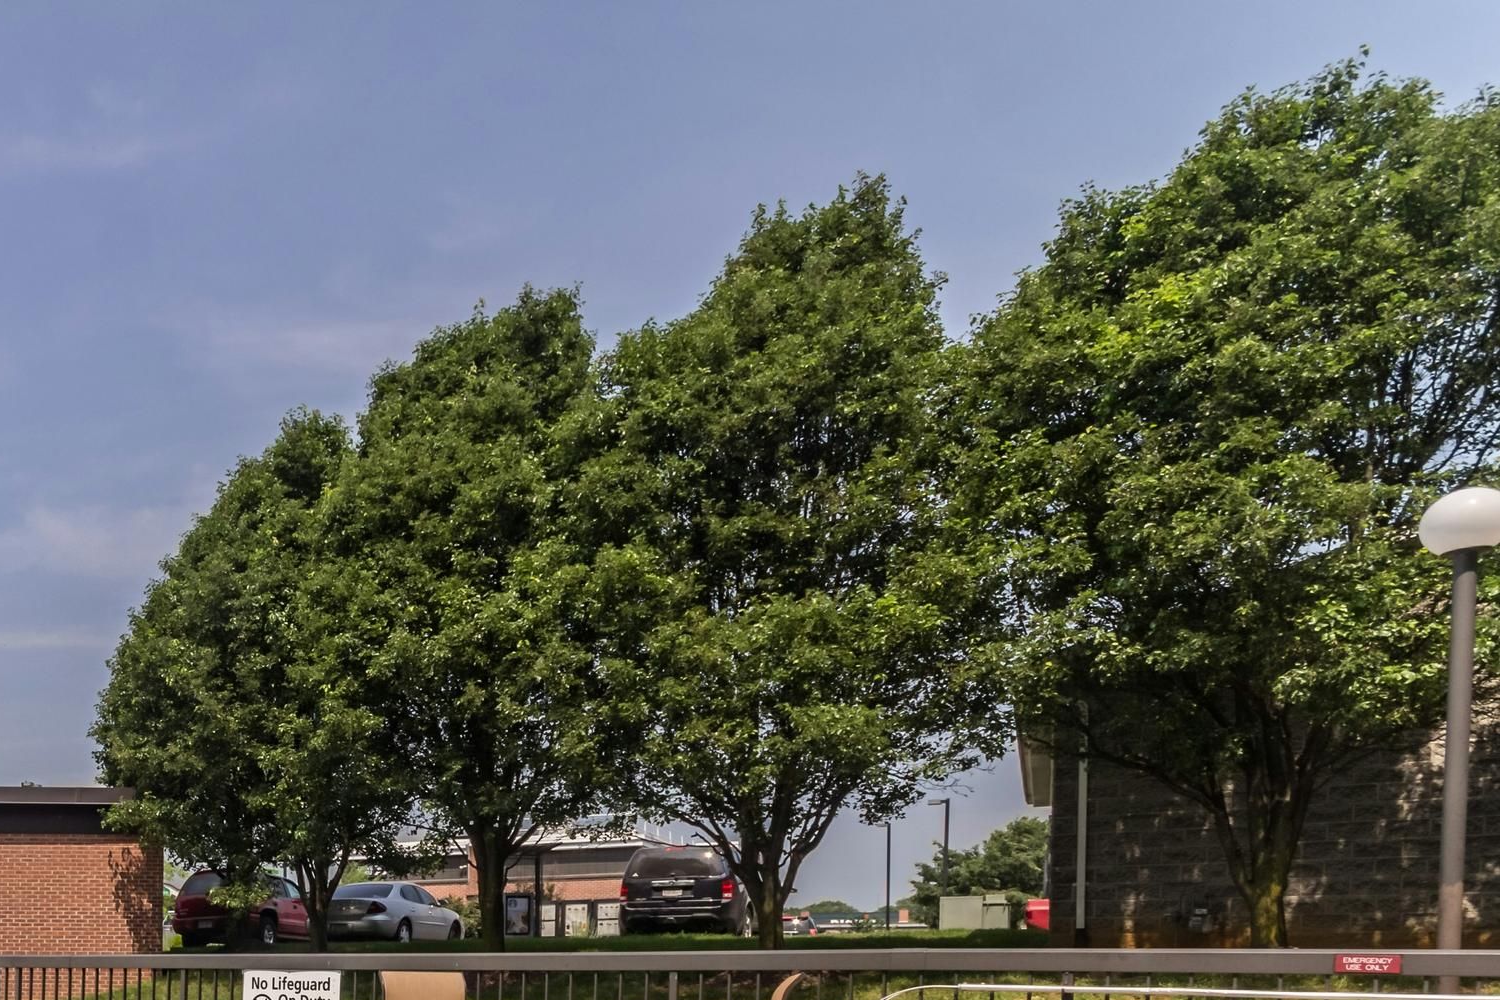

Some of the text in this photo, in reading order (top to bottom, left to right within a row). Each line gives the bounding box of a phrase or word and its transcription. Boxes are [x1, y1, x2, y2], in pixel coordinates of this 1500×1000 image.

[1342, 956, 1393, 964] EMERGENCY
[251, 976, 331, 994] No Lifeguard
